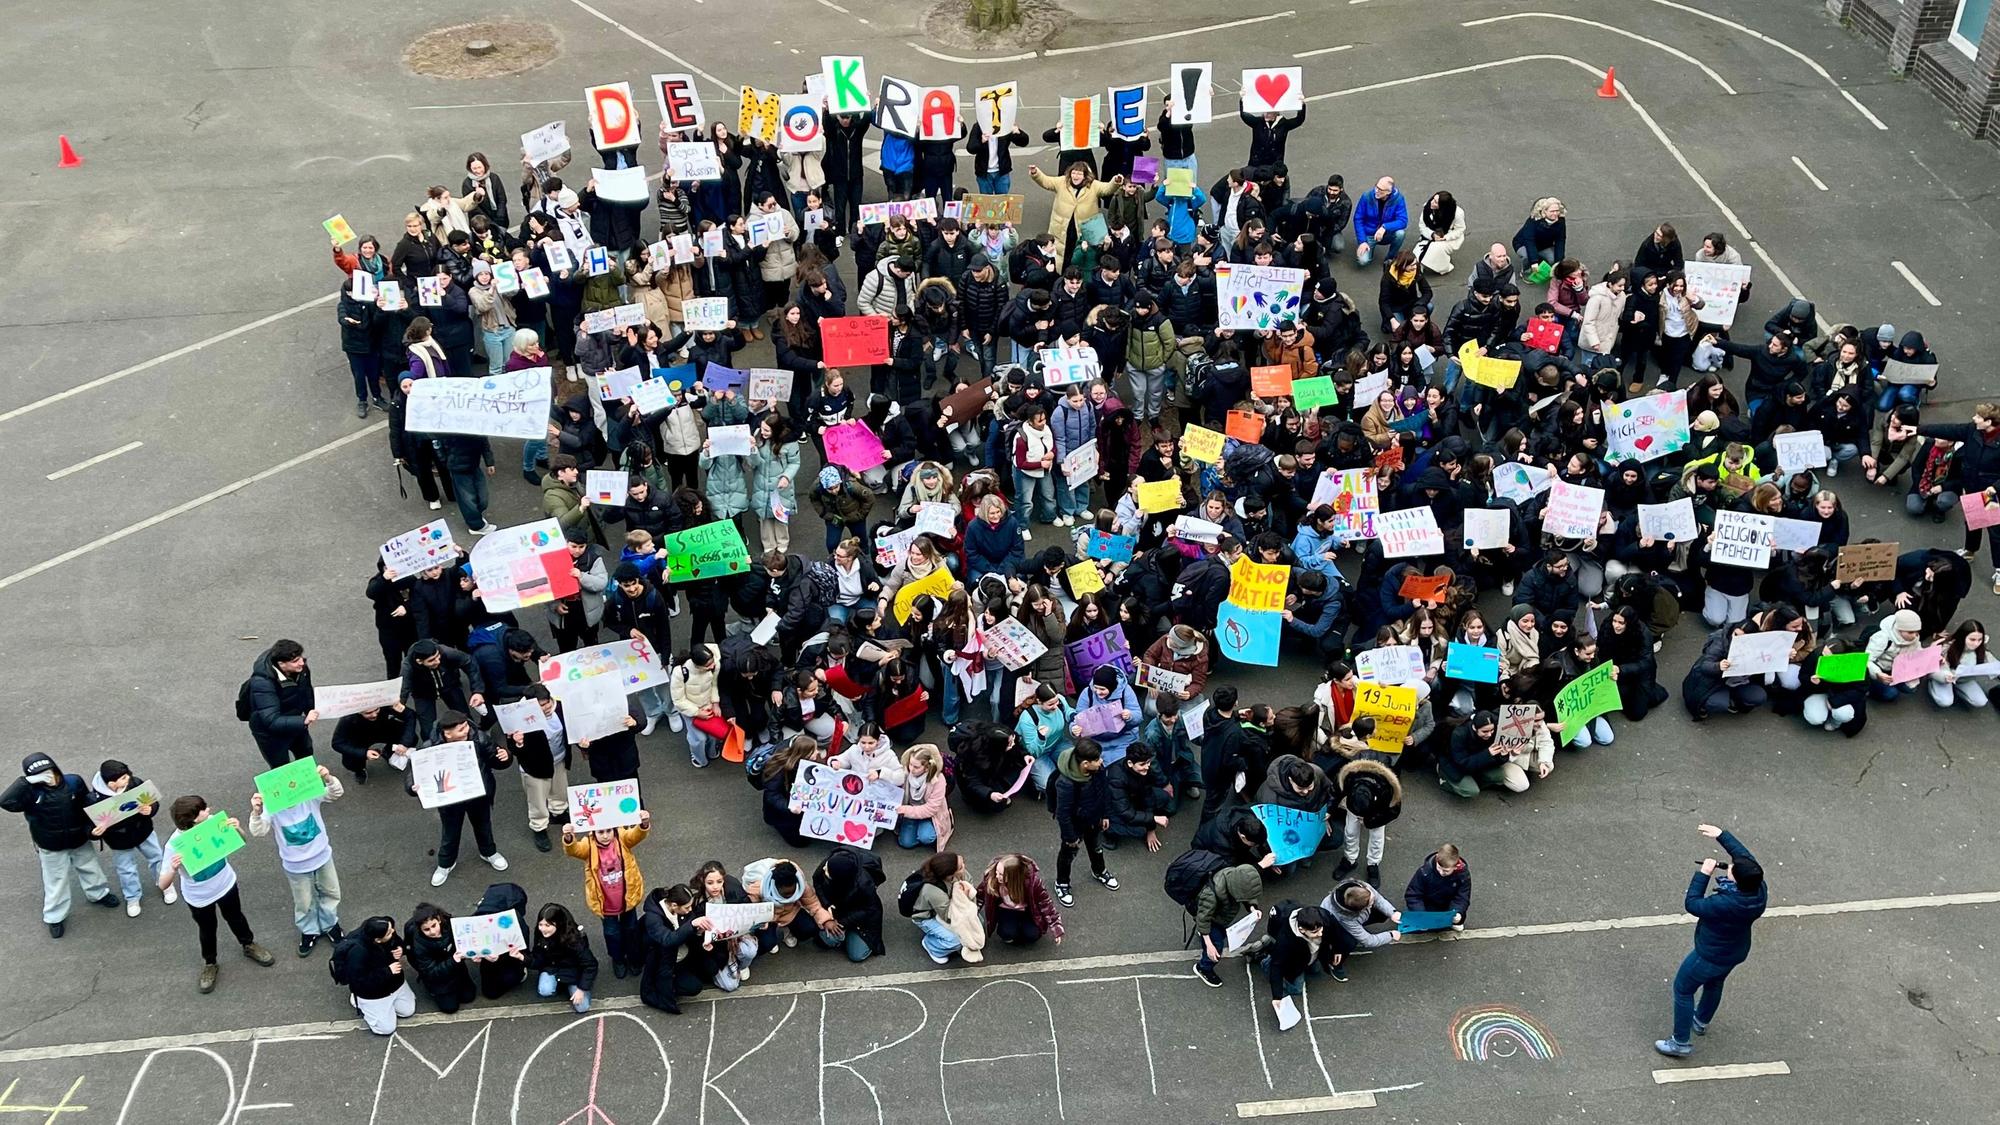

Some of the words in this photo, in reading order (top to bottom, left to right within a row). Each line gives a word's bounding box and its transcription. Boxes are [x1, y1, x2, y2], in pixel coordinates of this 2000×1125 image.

[1716, 524, 1773, 547] RELIGIONS
[1715, 541, 1762, 562] FREIHEIT
[1068, 629, 1122, 665] FÜR
[1582, 667, 1610, 690] STEH
[1382, 694, 1412, 712] Juni
